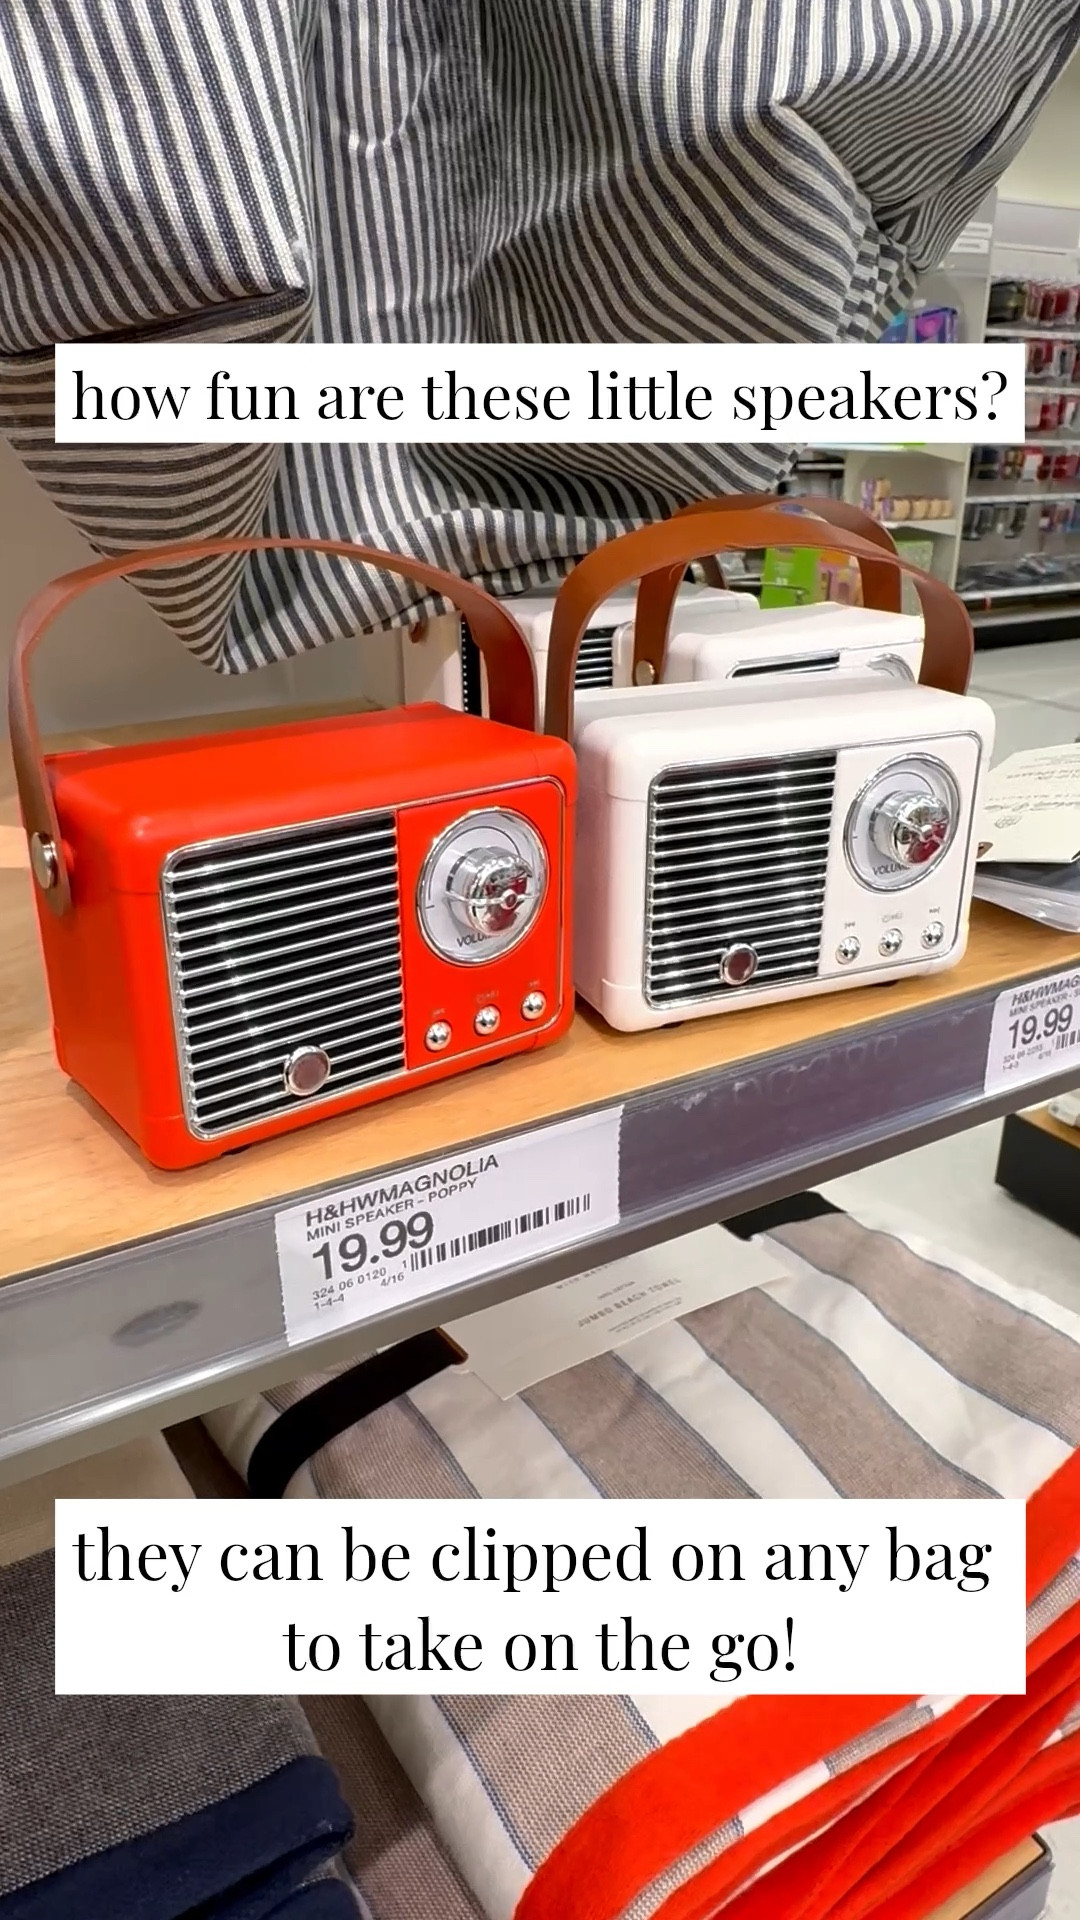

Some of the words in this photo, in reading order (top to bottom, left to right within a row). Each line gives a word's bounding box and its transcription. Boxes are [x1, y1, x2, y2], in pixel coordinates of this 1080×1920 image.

[456, 932, 492, 947] VOLU
[1029, 992, 1068, 1011] SPEAKER
[1008, 1003, 1073, 1049] 19.99
[306, 1154, 499, 1227] H&HWMAGNOLIA
[306, 1220, 341, 1241] MINI
[345, 1198, 414, 1229] SPEAKER
[429, 1178, 478, 1203] POPPY
[312, 1211, 434, 1280] 19.99
[312, 1284, 335, 1300] 324
[338, 1278, 353, 1292] 06
[357, 1266, 386, 1285] 0120
[380, 1273, 405, 1287] 4/16
[314, 1293, 345, 1310] 1-4-4
[577, 1306, 614, 1328] JUMBO
[614, 1291, 647, 1310] BEACH
[648, 1277, 683, 1293] TOWEL
